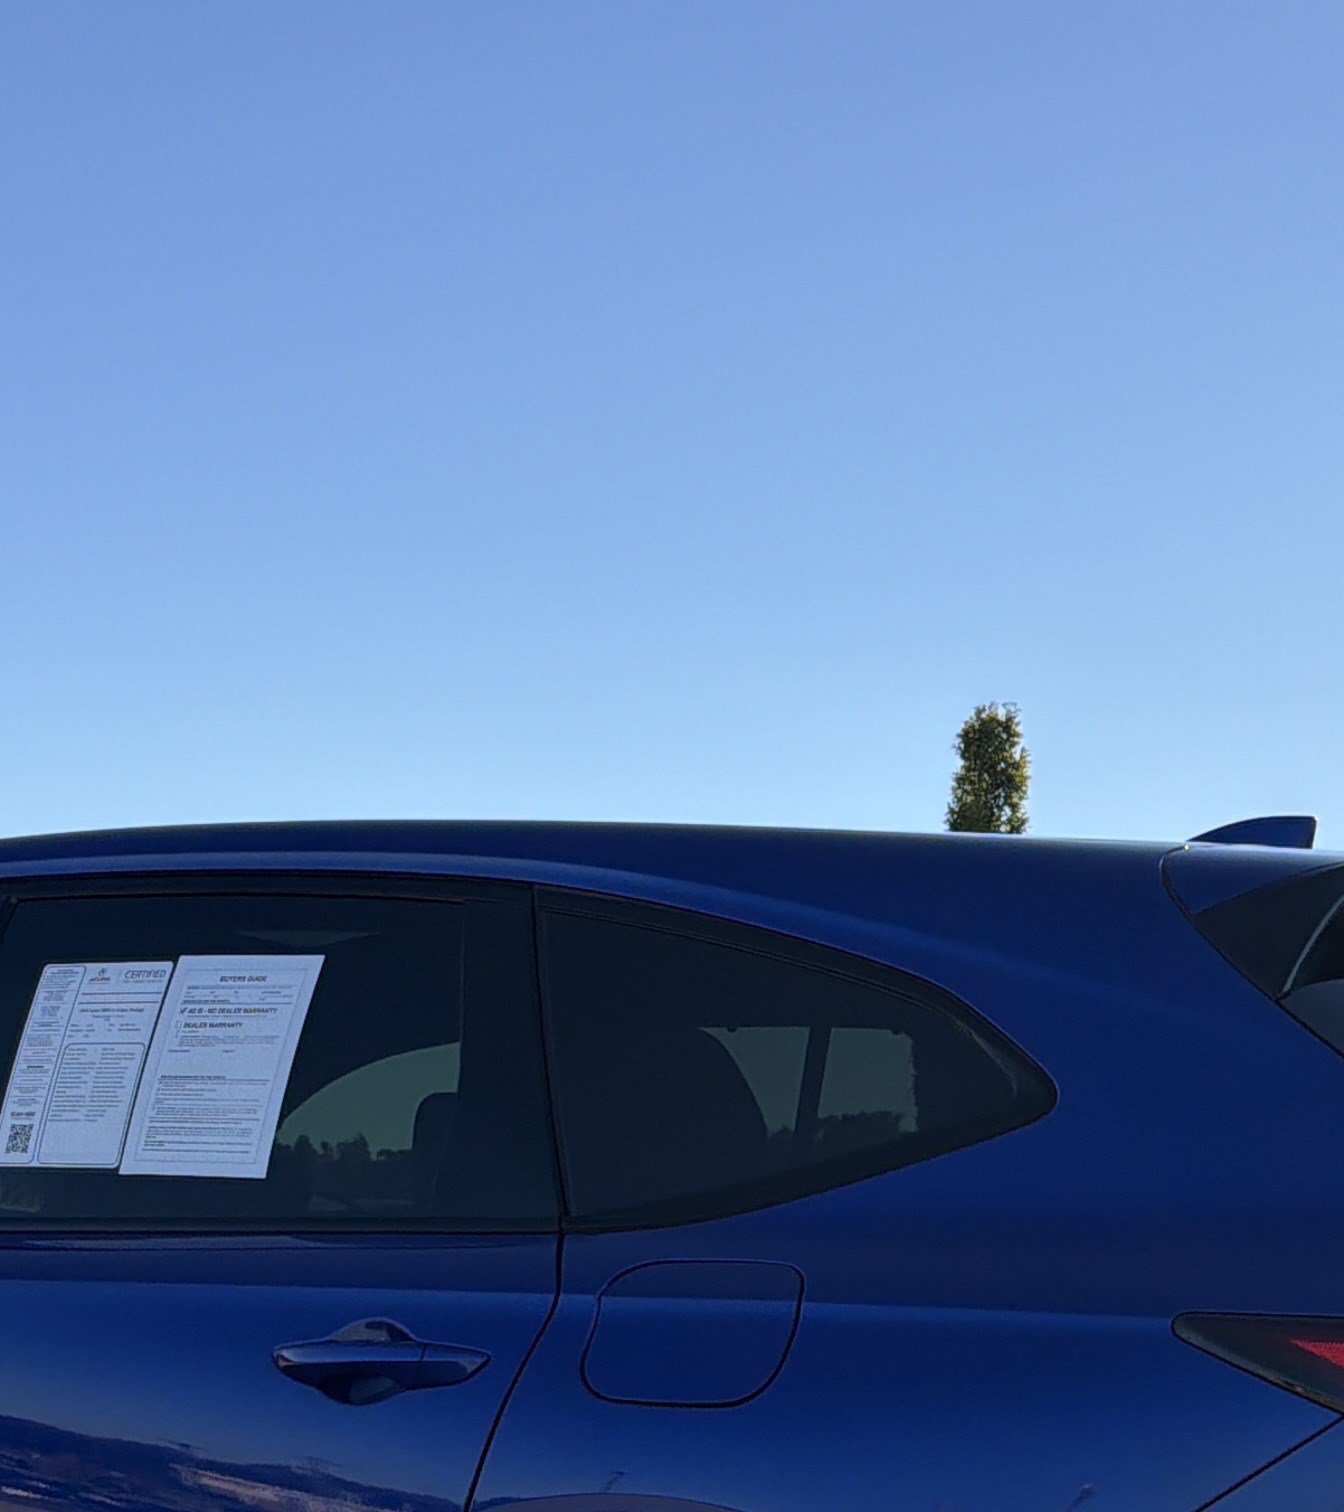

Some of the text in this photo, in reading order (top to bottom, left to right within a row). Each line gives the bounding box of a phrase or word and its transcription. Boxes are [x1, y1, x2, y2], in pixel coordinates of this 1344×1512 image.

[124, 968, 167, 980] CERTIFIED
[219, 975, 268, 983] BUYERS GUIDE
